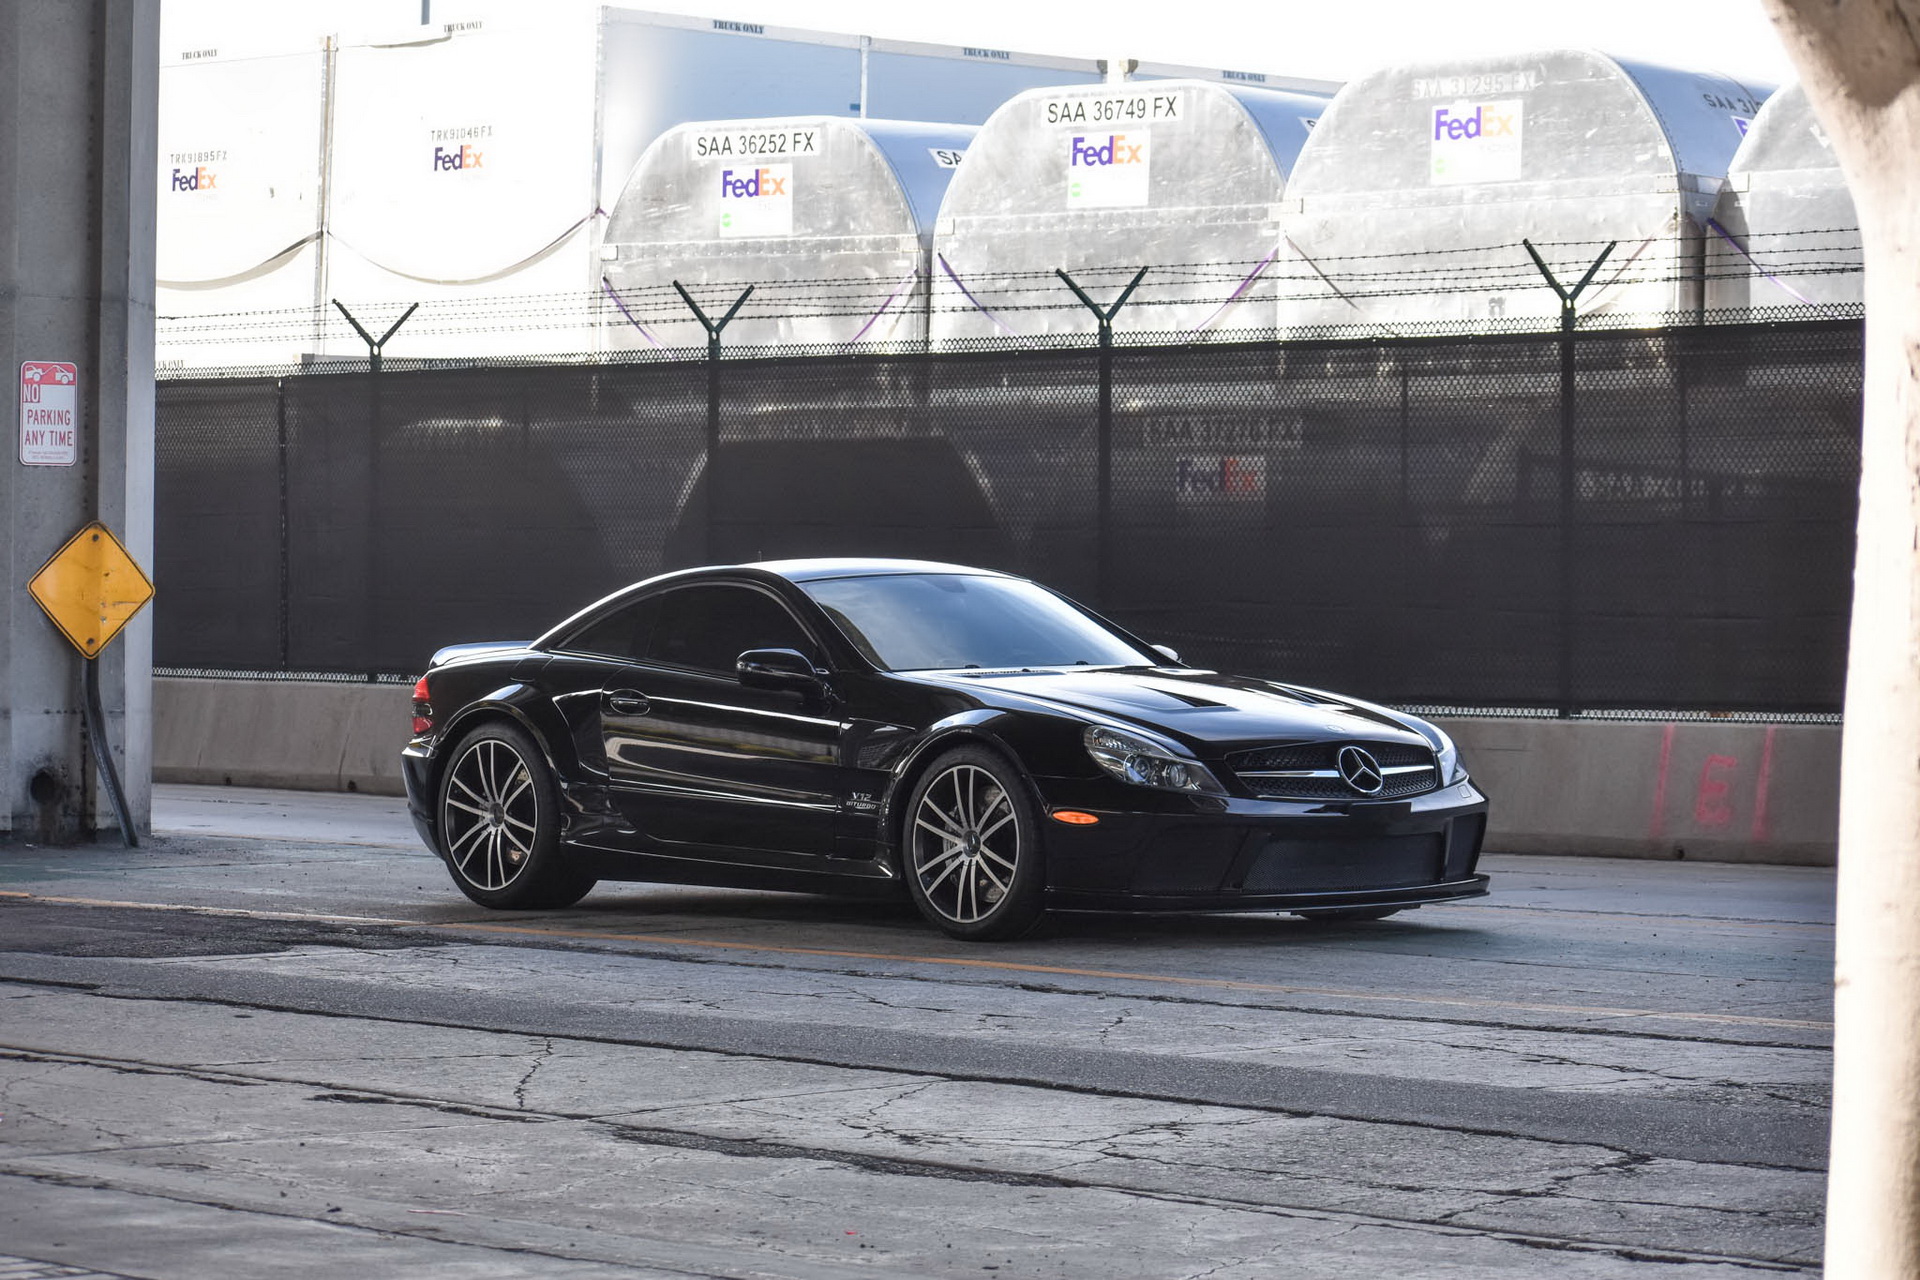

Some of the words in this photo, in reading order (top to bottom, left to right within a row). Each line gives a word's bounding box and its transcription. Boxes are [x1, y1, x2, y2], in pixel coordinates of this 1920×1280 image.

[467, 21, 483, 30] ONLY
[713, 19, 741, 31] TRUCK
[742, 22, 764, 34] ONLY
[203, 49, 218, 58] ONLY
[963, 47, 989, 58] TRUCK
[990, 50, 1010, 60] ONLY
[1222, 70, 1246, 80] TRUCK
[1048, 102, 1086, 123] SAA
[1093, 98, 1146, 121] 36749
[1153, 96, 1177, 117] FX
[1703, 93, 1737, 111] SAA
[1435, 105, 1513, 140] FedEx
[697, 136, 732, 156] SAA
[739, 133, 787, 155] 36252
[793, 131, 814, 152] FX
[1072, 135, 1142, 166] FedEx
[434, 144, 483, 171] FedEx
[937, 150, 963, 165] SA
[172, 165, 216, 192] FedEx
[722, 168, 785, 198] FedEx
[23, 383, 40, 402] NO
[27, 409, 71, 426] PARKING
[25, 430, 45, 446] ANY
[49, 430, 73, 447] TIME
[1177, 457, 1258, 493] FedEx
[852, 791, 872, 801] V12
[846, 800, 876, 810] BITURBO
